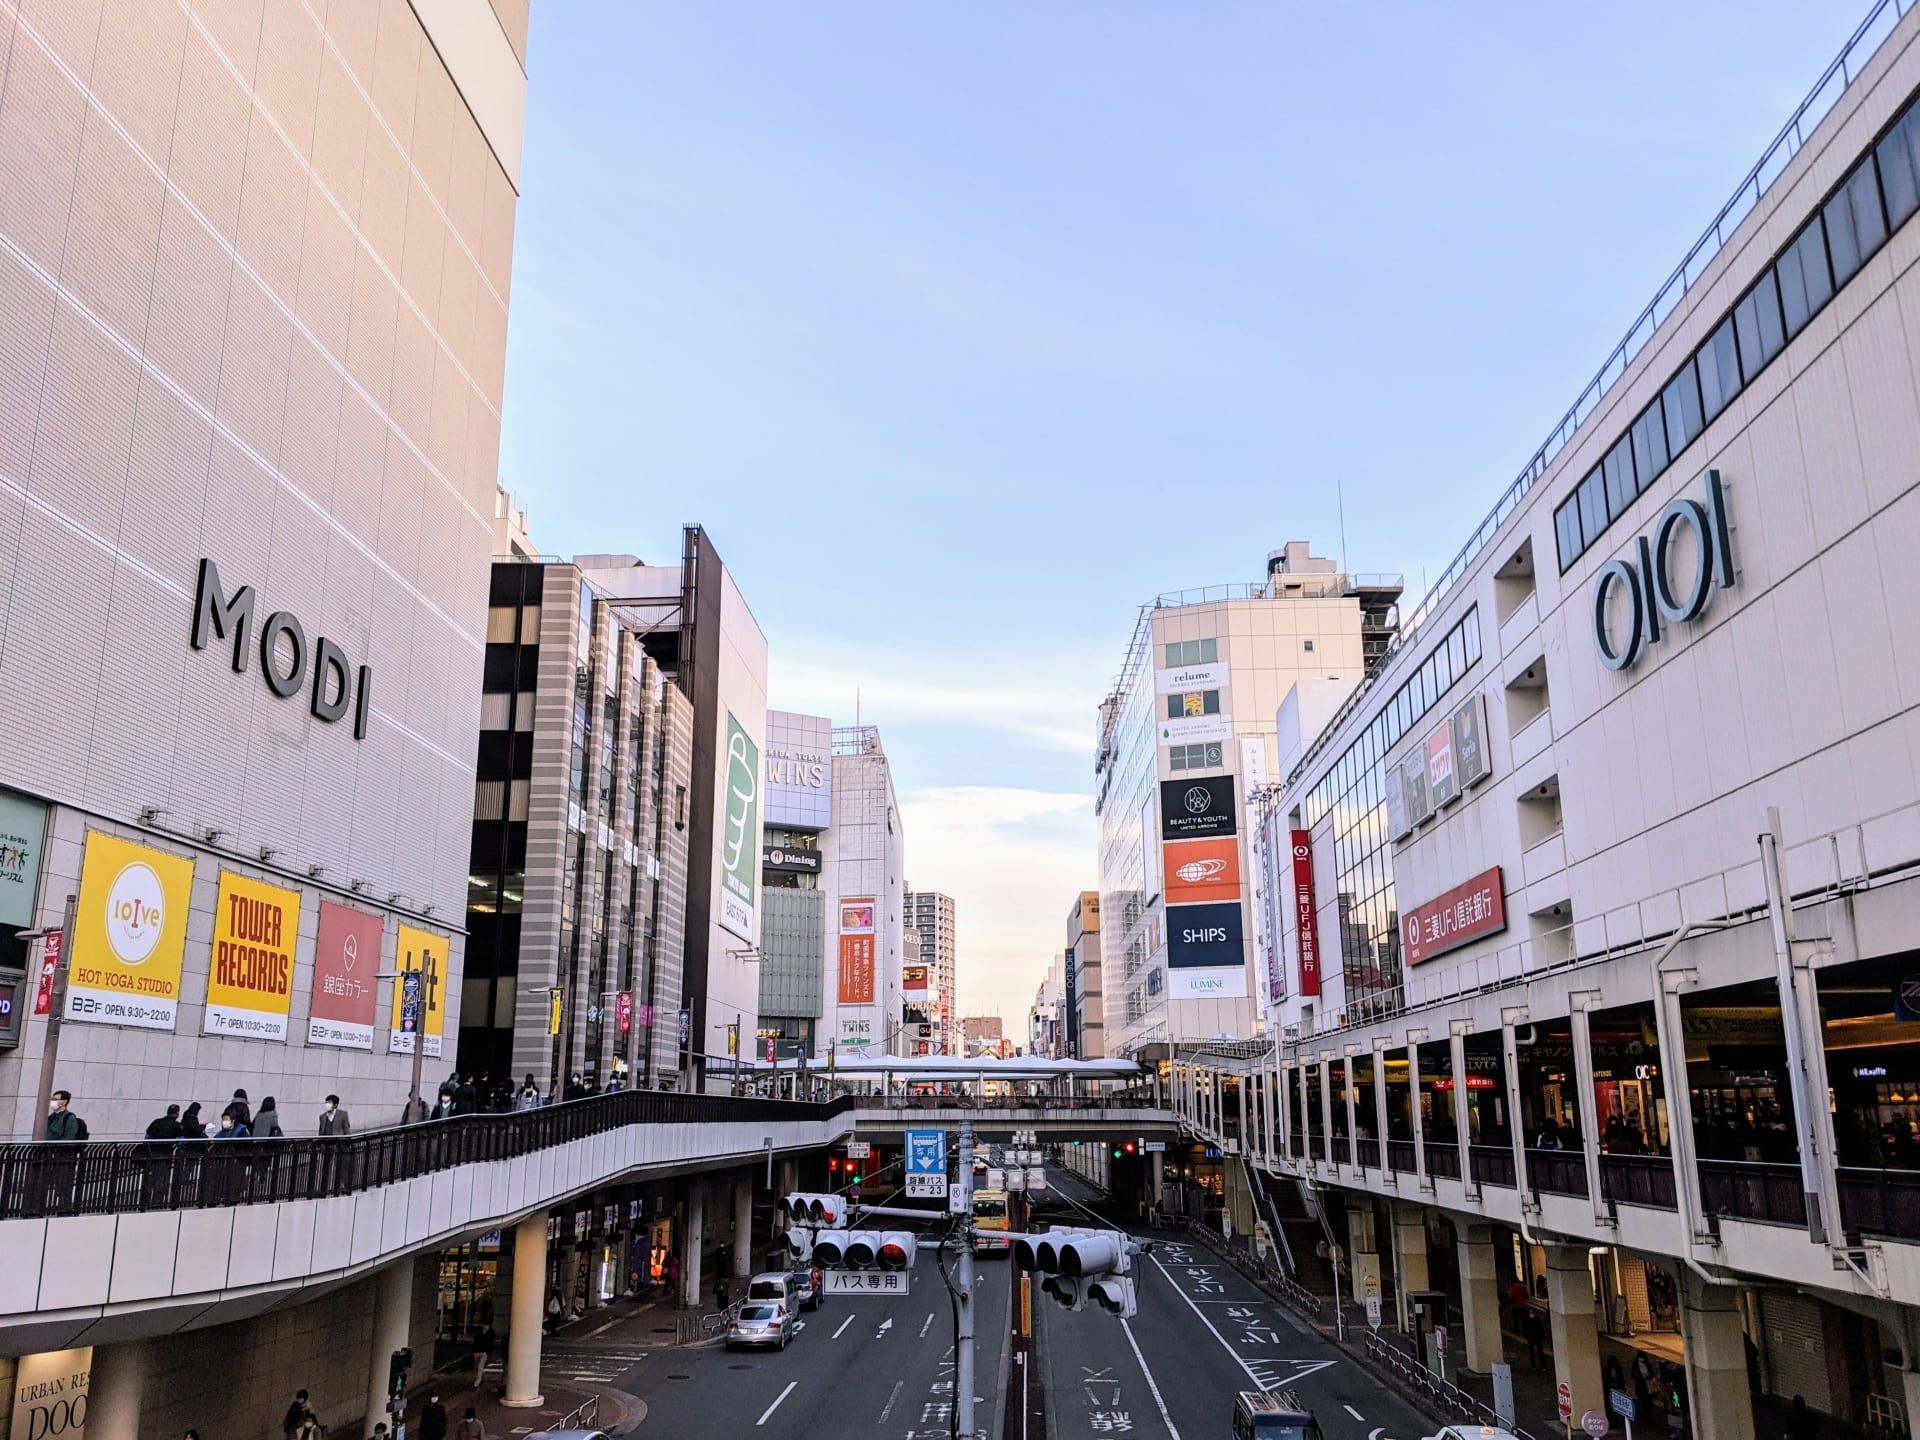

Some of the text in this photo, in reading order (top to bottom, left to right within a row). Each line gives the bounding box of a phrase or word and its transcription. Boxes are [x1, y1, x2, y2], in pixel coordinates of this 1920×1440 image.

[190, 558, 372, 740] MODI
[1174, 671, 1211, 682] relume
[767, 760, 824, 788] WINS
[784, 855, 816, 866] Dining
[230, 893, 282, 947] TOWER
[1424, 888, 1491, 943] 三菱UFJ信託銀行
[1183, 928, 1226, 943] SHIPS
[1299, 884, 1314, 972] 三菱UFJ信託銀行
[217, 940, 288, 995] RECORDS
[77, 967, 173, 994] HOT YOGA STUDIO
[323, 973, 369, 999] 銀座カラー
[1190, 979, 1224, 990] LUMINE
[72, 996, 102, 1014] B2F
[213, 1013, 227, 1027] 7F
[843, 1023, 870, 1033] TWINS
[311, 1025, 329, 1038] B2F
[909, 1176, 942, 1185] 路線バス
[833, 1275, 899, 1289] バス専用
[20, 1377, 65, 1403] URBAN
